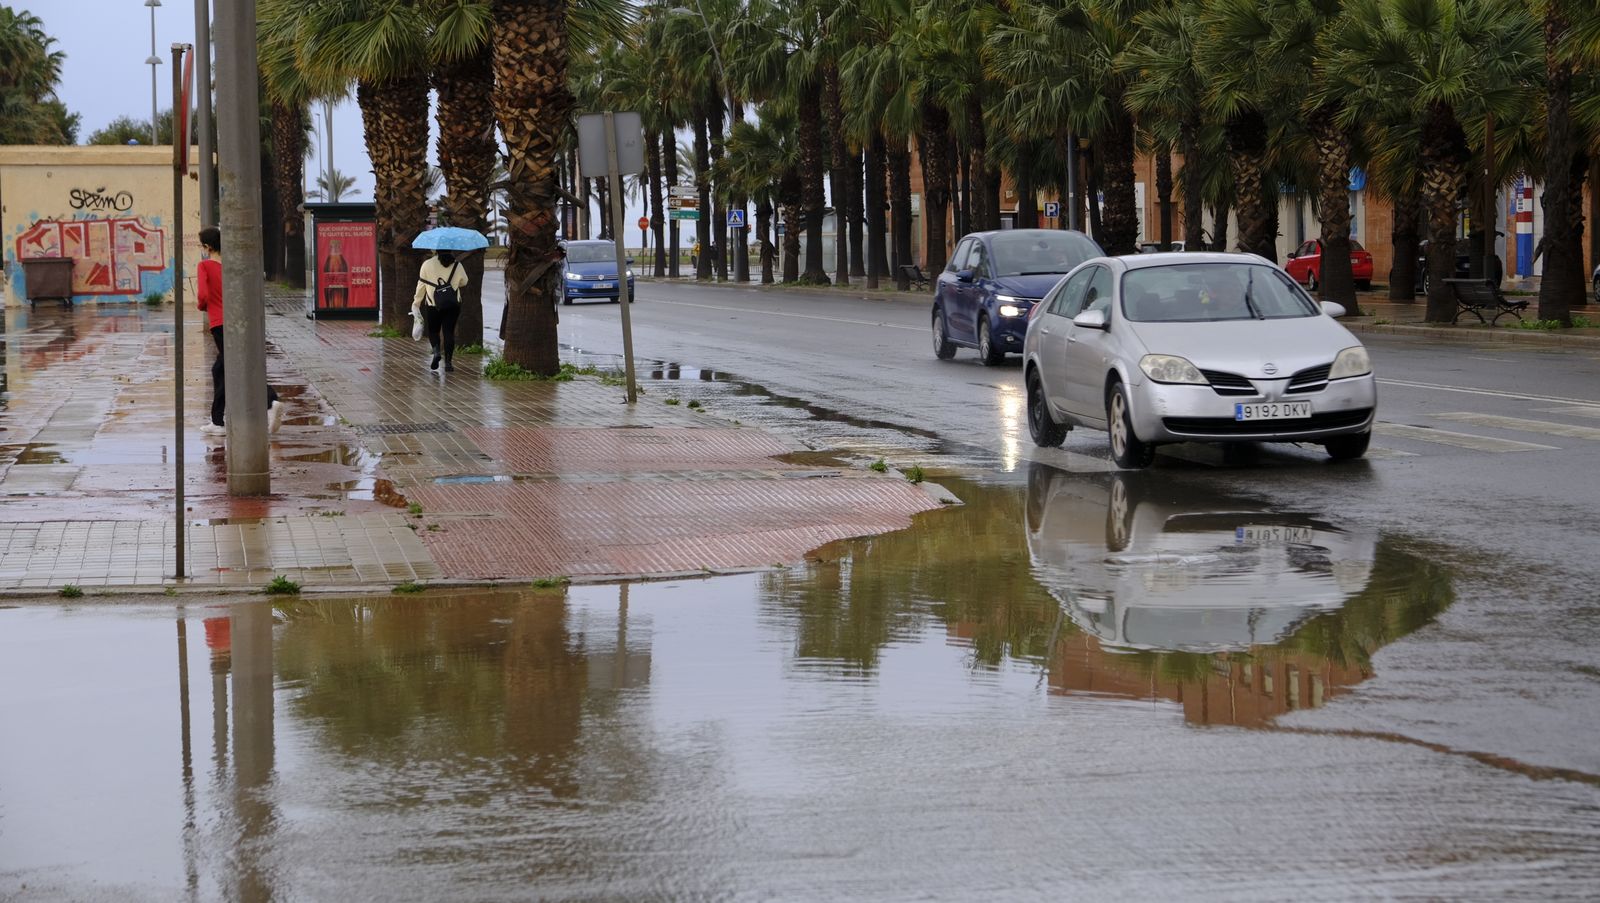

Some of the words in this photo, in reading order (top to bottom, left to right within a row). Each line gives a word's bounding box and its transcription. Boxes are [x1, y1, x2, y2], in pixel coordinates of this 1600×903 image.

[1047, 204, 1056, 216] P
[1245, 404, 1278, 418] 9192
[1283, 403, 1308, 417] DKV
